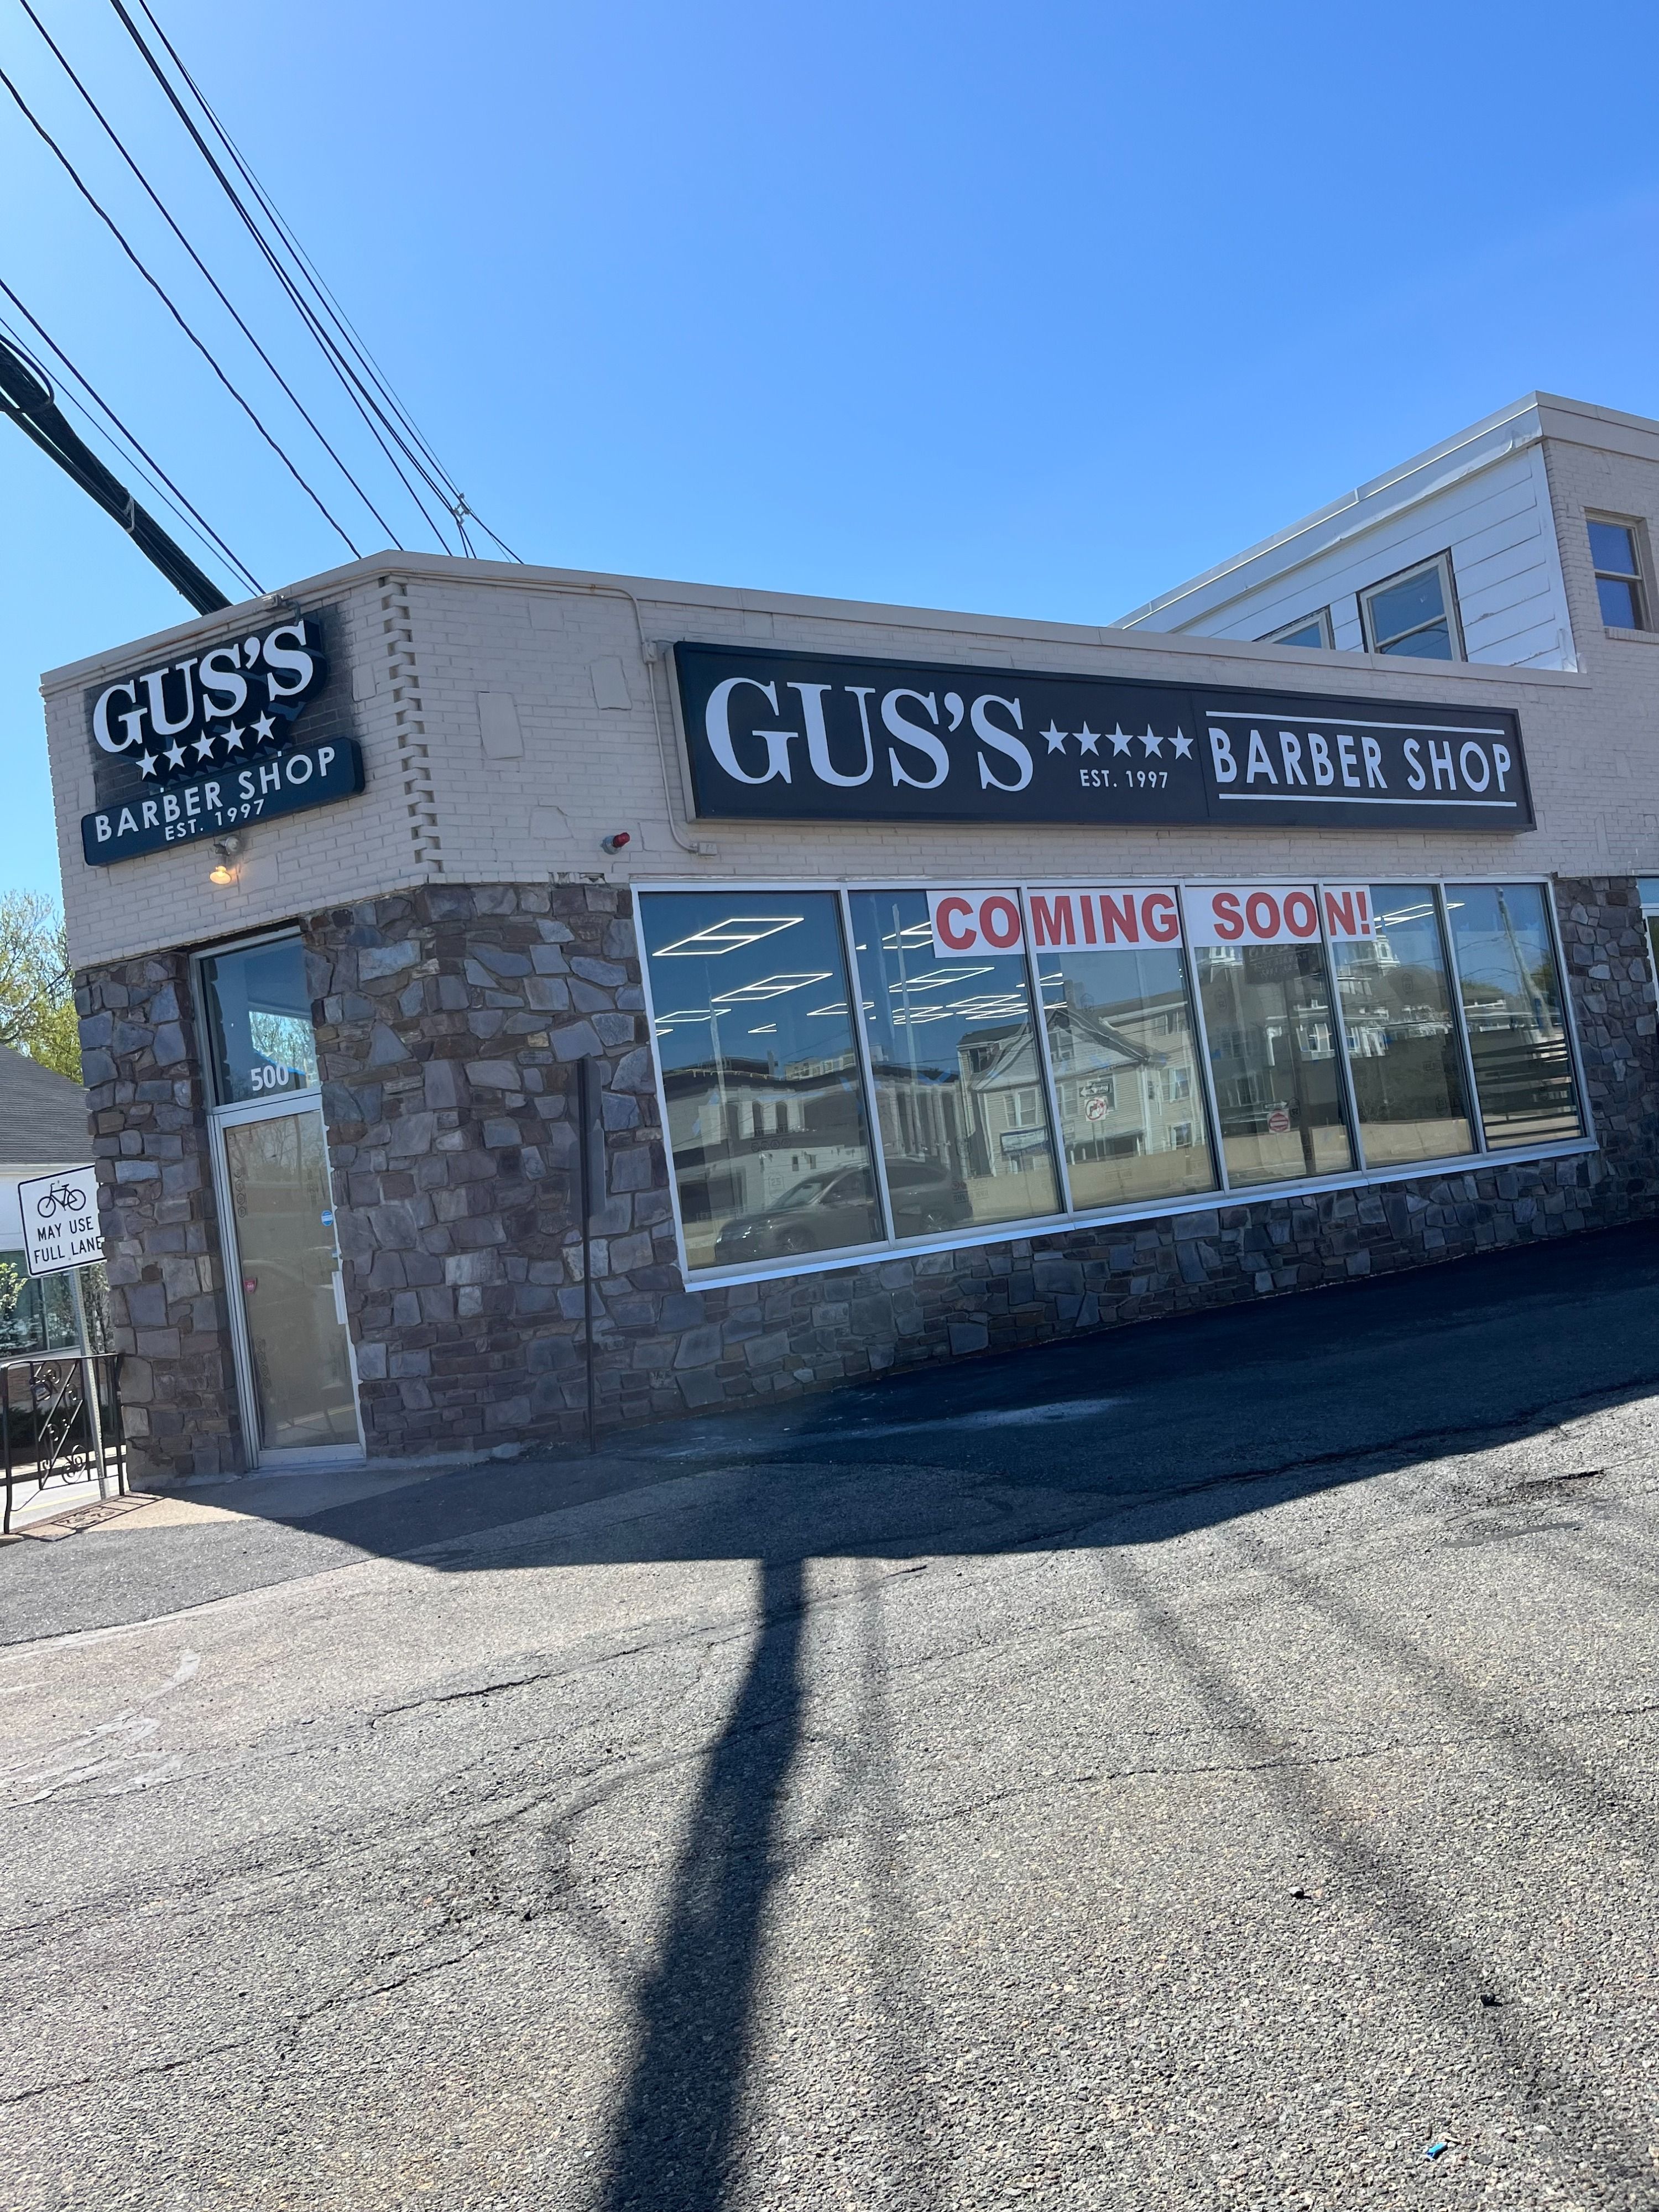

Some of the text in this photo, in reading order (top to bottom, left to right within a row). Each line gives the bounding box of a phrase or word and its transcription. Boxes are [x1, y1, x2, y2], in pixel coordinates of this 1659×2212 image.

[93, 619, 314, 754] GUS'S
[705, 677, 1033, 792] GUS'S
[1079, 769, 1168, 790] EST. 1997
[1208, 727, 1511, 793] BARBER SHOP
[95, 746, 336, 843] BARBER SHOP
[165, 799, 265, 841] EST. 1997
[936, 891, 1371, 950] COMING SOON!
[251, 1063, 289, 1092] 500
[34, 1235, 103, 1264] FULL LANE
[37, 1216, 94, 1241] MAY USE
